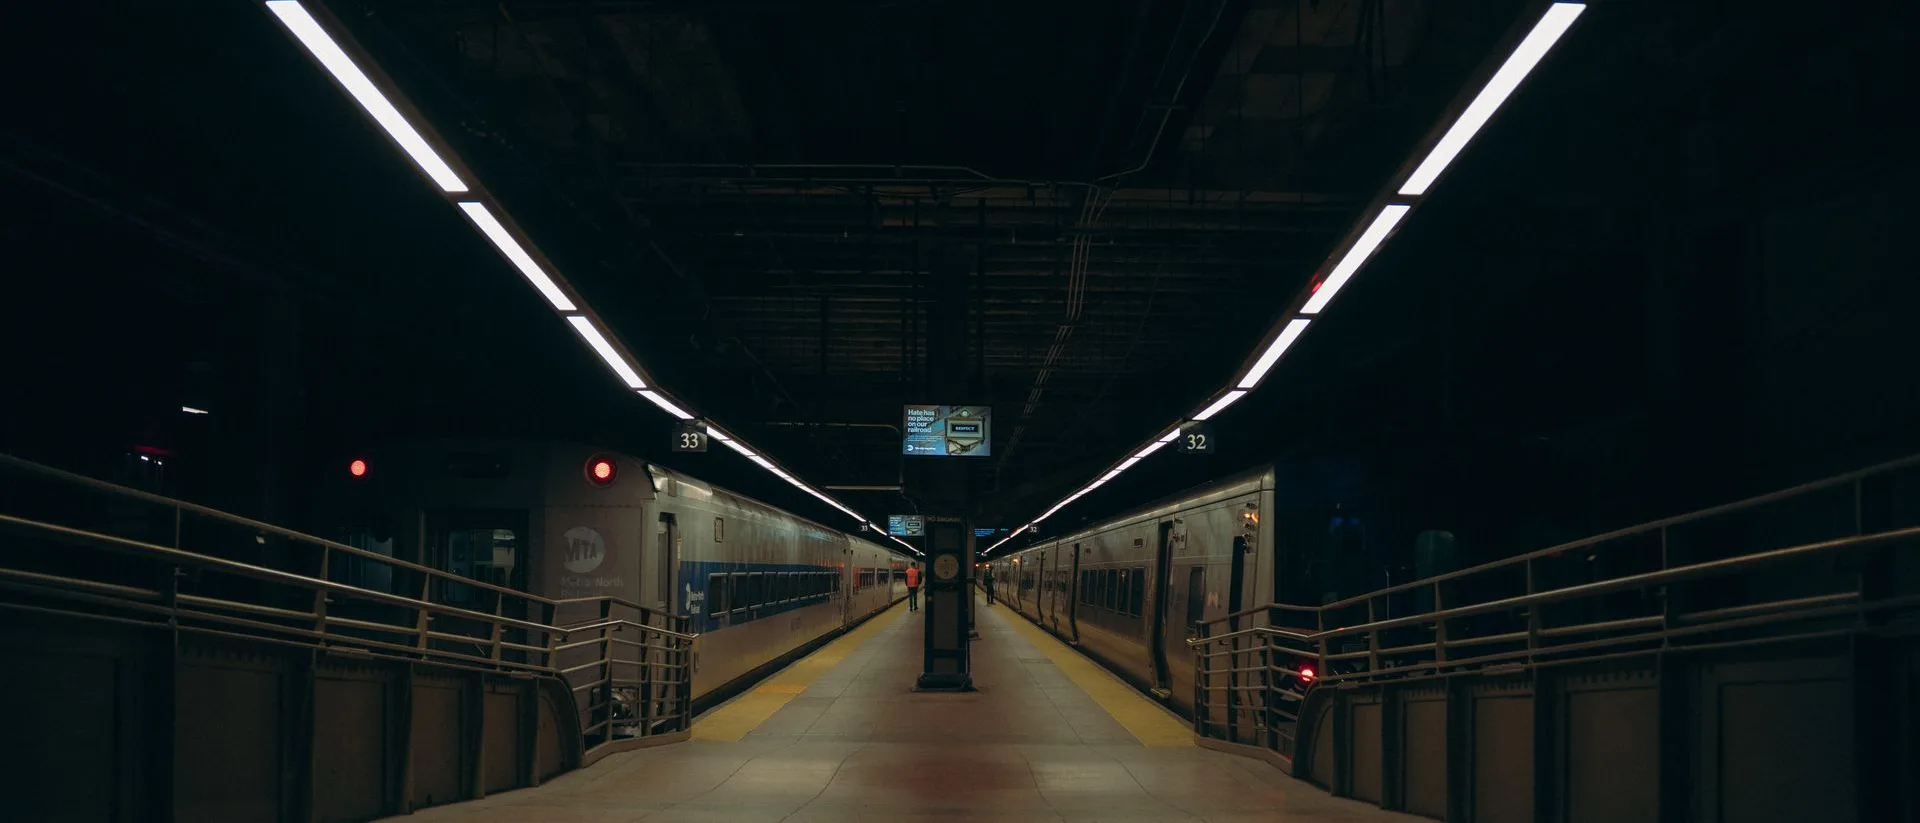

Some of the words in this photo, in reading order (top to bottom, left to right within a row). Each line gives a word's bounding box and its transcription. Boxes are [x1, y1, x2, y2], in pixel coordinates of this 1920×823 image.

[680, 432, 698, 448] 33
[1187, 434, 1206, 450] 32
[564, 538, 597, 562] MTA
[595, 577, 624, 588] North
